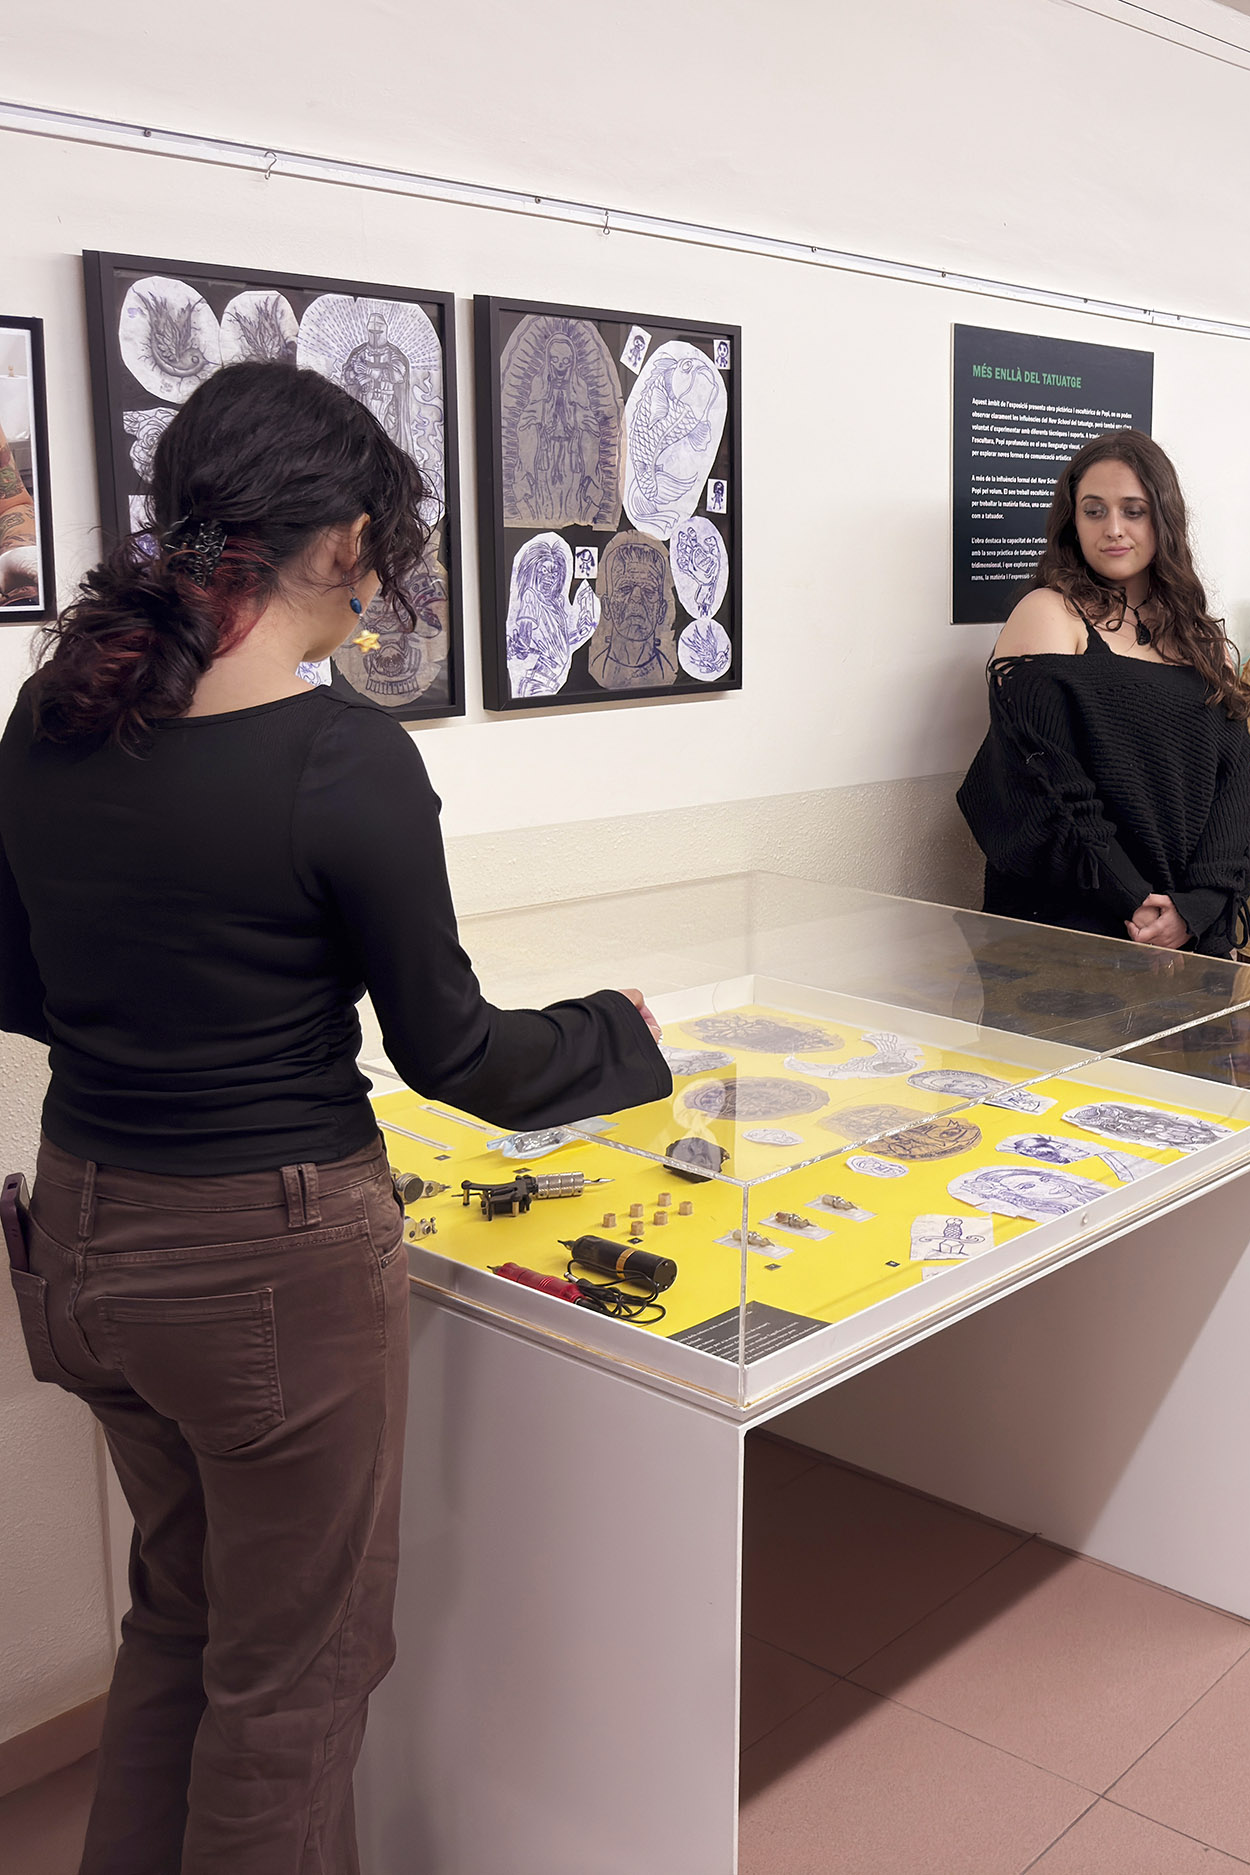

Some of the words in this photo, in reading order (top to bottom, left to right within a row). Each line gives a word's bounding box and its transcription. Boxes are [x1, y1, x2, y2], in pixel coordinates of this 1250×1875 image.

[973, 363, 992, 378] MÉS
[995, 367, 1022, 382] ENLLÀ
[1024, 371, 1040, 384] DEL
[1042, 373, 1082, 389] TATUATGE
[972, 398, 987, 406] Aquest
[1007, 401, 1028, 409] l'exposició
[990, 425, 1021, 434] d'experimentar
[1031, 428, 1048, 436] diferents
[972, 437, 995, 445] l'escultura,
[1006, 439, 1029, 447] aprofundeix
[980, 450, 997, 458] explorar
[1010, 451, 1024, 459] formes
[1031, 453, 1055, 461] comunicació
[997, 549, 1013, 557] pràctica
